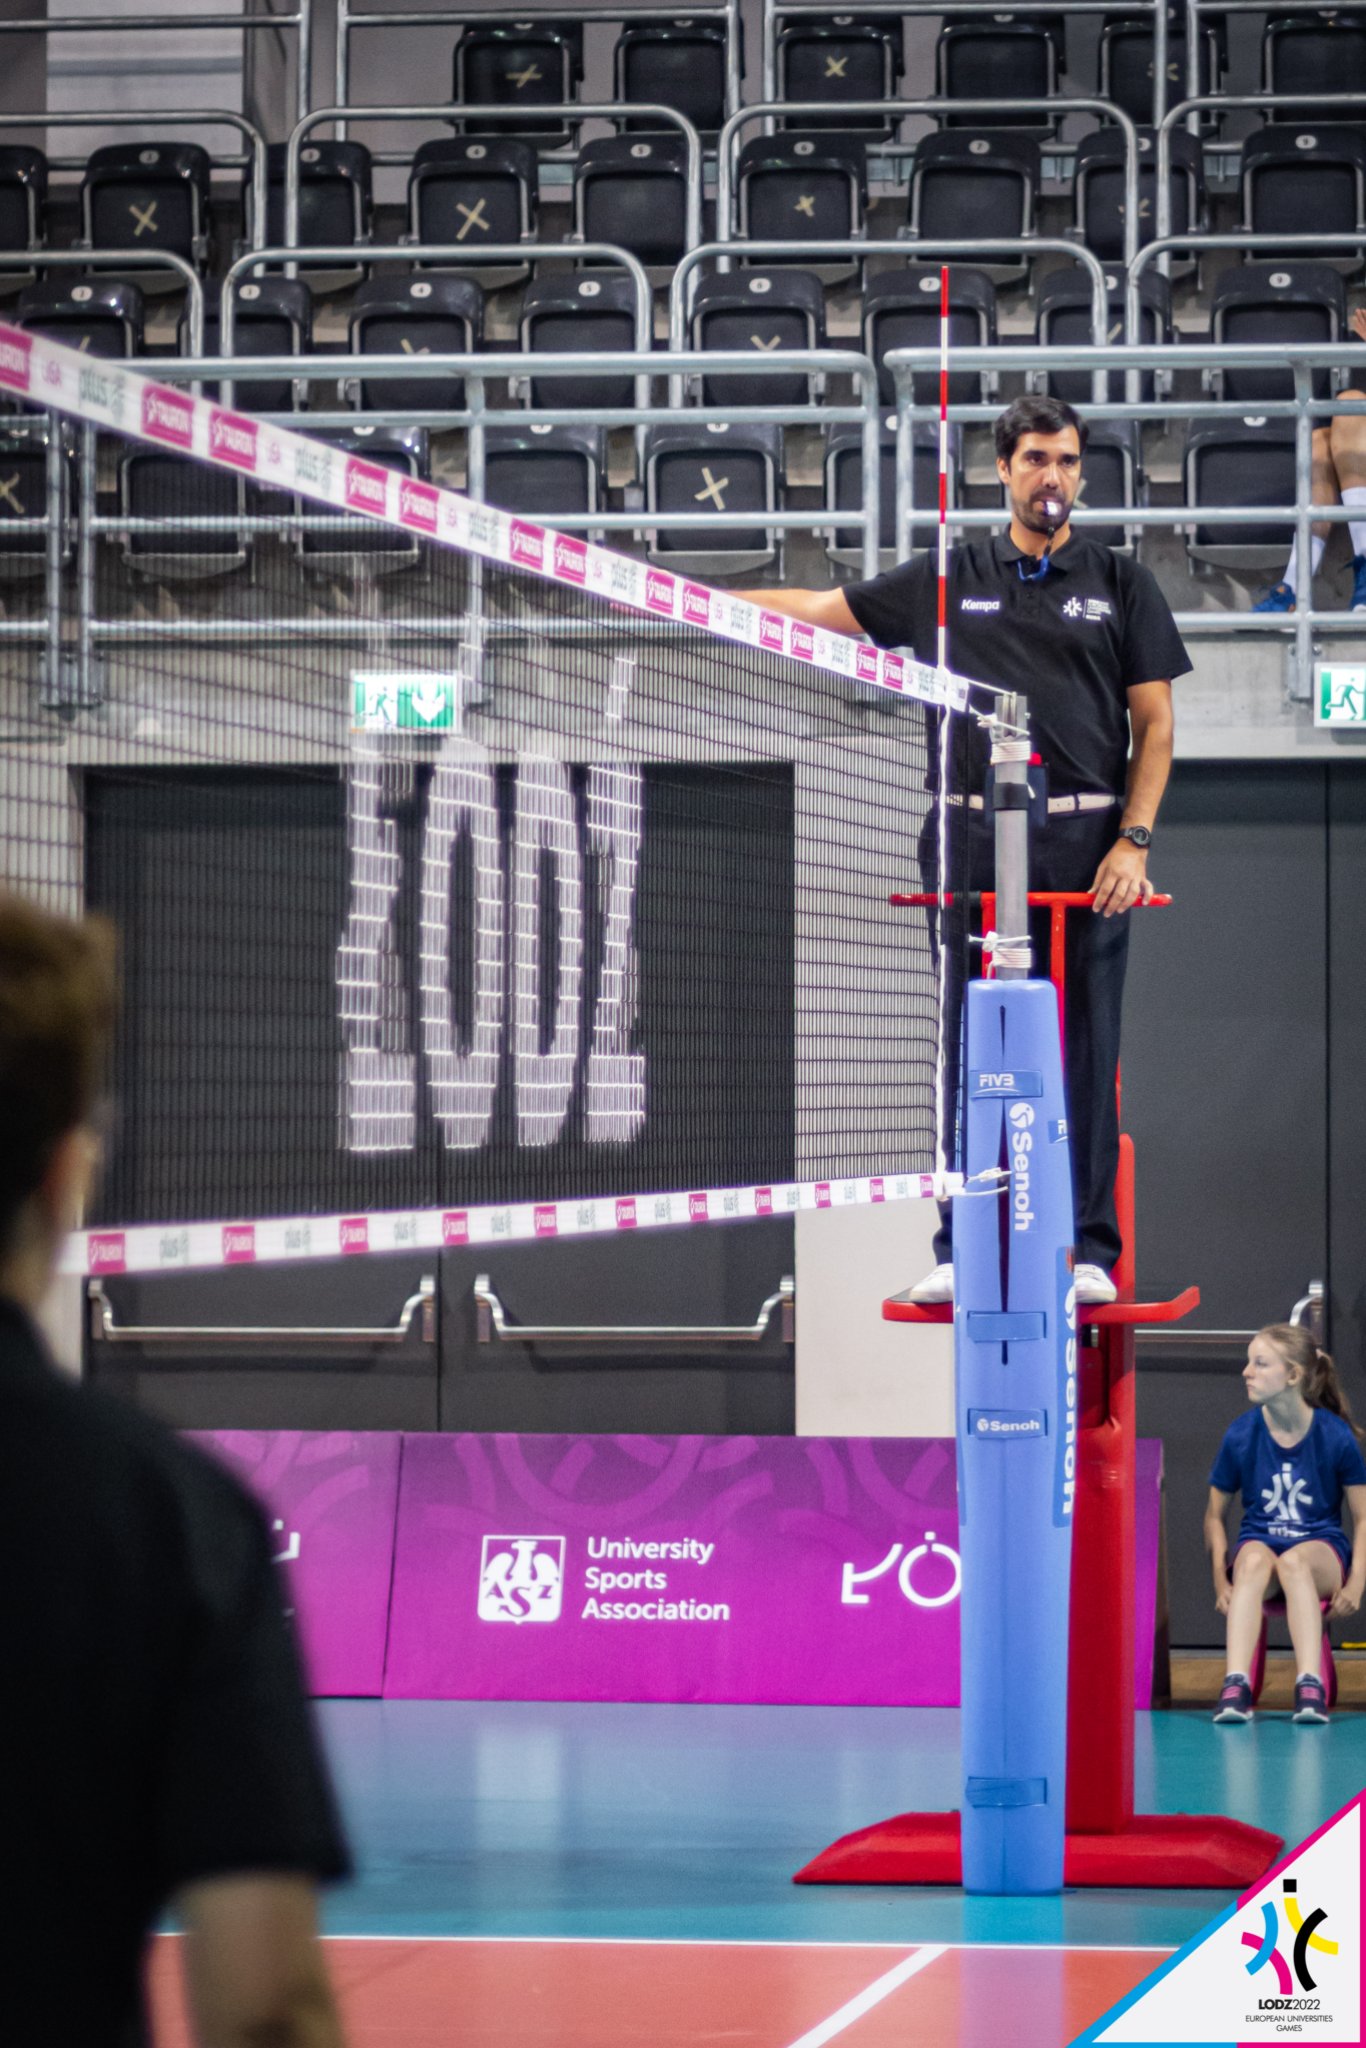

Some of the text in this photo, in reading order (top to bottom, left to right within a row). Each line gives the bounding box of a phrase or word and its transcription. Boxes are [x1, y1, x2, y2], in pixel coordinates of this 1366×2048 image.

[962, 599, 1000, 612] Kempa
[979, 1073, 1014, 1087] FIVB
[1012, 1132, 1034, 1231] Senoh
[990, 1420, 1040, 1432] Senoh
[588, 1536, 714, 1564] University
[584, 1566, 668, 1593] Sports
[582, 1597, 730, 1621] Association
